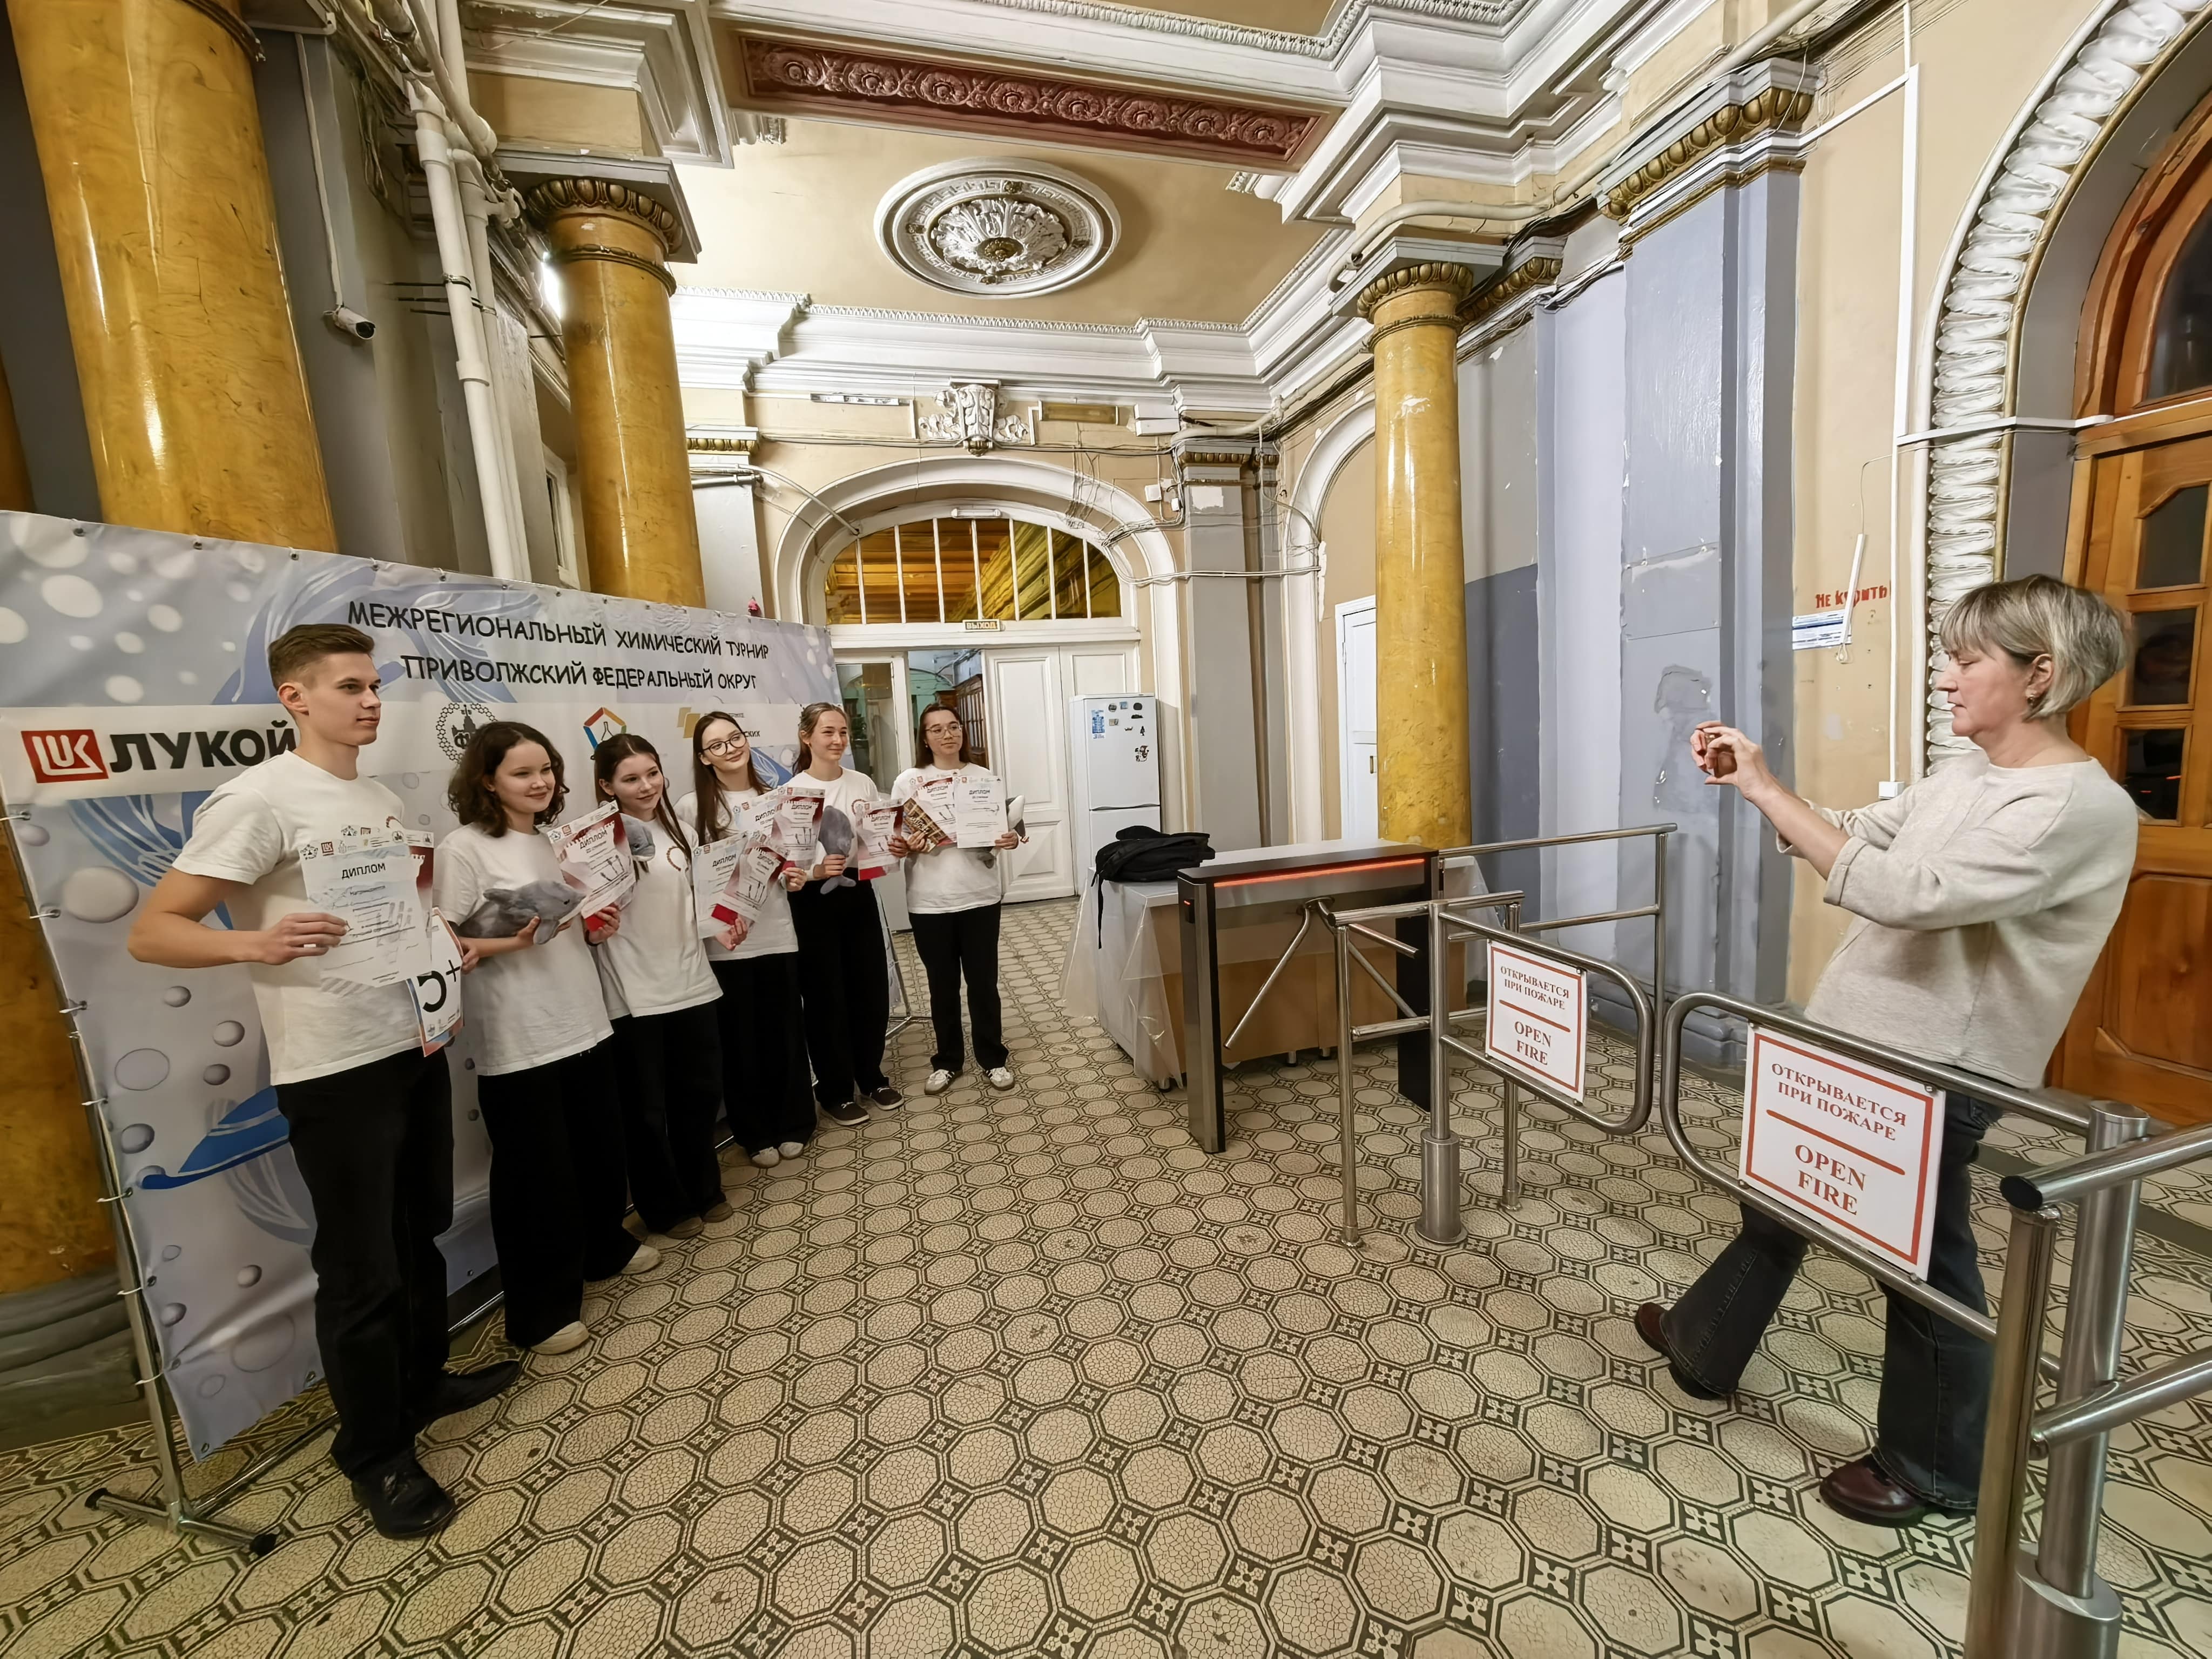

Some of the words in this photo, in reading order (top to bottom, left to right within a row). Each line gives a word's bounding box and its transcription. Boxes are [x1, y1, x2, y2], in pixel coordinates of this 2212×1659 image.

[1815, 594, 1831, 609] НЕ
[348, 601, 606, 646] МЕЖРЕГИОНАЛЬНЫЙ
[615, 629, 722, 656] ХИМИЧЕСКИЙ
[726, 640, 768, 659] ТУРНИР
[400, 655, 587, 685] ПРИВОЛЖСКИЙ
[592, 666, 713, 689] ФЕДЕРАЛЬНЫЙ
[718, 673, 757, 690] ОКРУГ
[580, 830, 608, 849] ДИПЛОМ
[341, 862, 386, 880] ДИПЛОМ
[1500, 966, 1569, 999] ОТКРЫВАЕТСЯ
[1504, 979, 1522, 993] ПРИ
[1524, 987, 1566, 1010] ПОЖАРЕ
[1514, 1021, 1552, 1048] OPEN
[1516, 1040, 1548, 1065] FIRE
[1771, 1063, 1907, 1127] ОТКРЫВАЕТСЯ
[1778, 1082, 1812, 1105] ПРИ
[1817, 1099, 1896, 1141] ПОЖАРЕ
[1795, 1144, 1867, 1192] OPEN
[1797, 1170, 1858, 1216] FIRE
